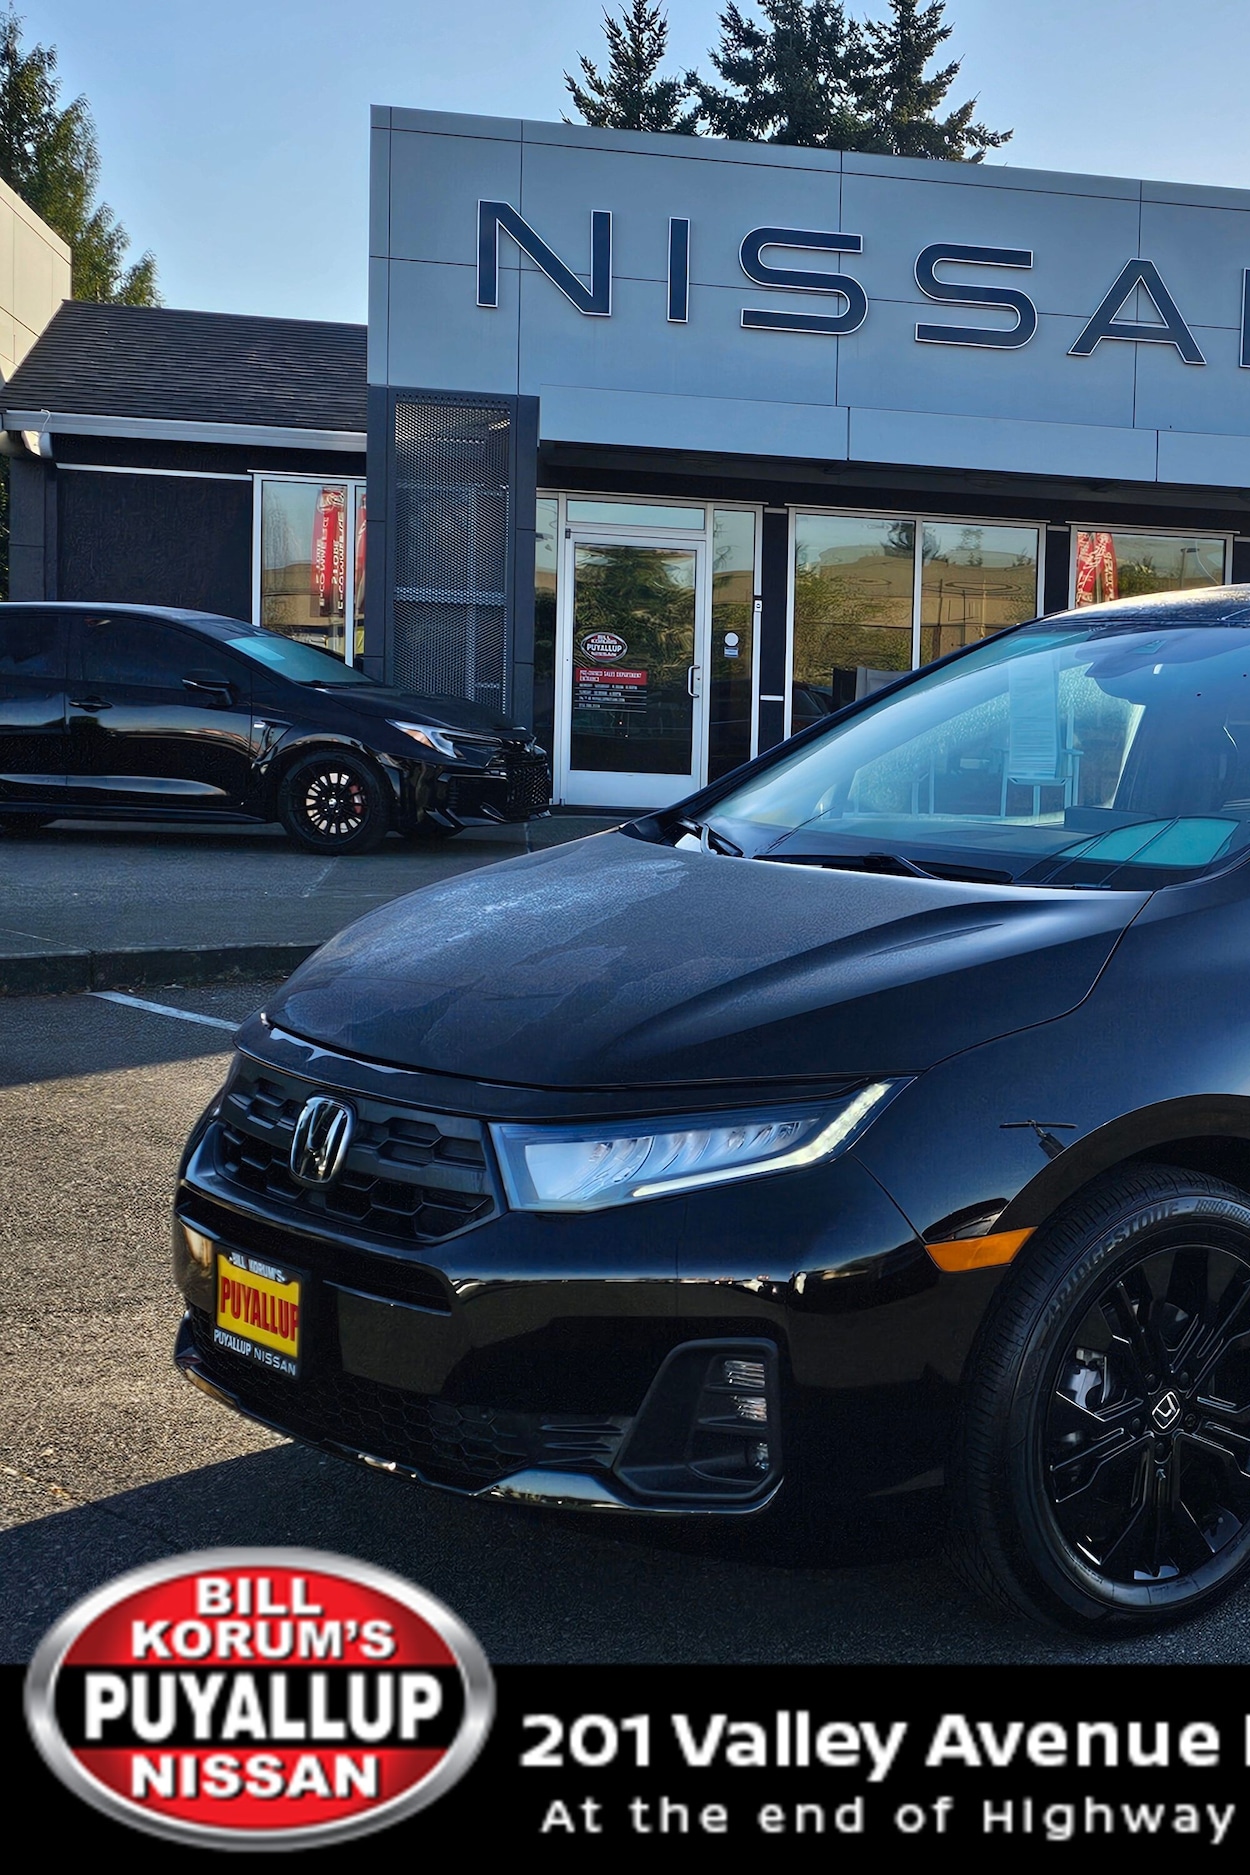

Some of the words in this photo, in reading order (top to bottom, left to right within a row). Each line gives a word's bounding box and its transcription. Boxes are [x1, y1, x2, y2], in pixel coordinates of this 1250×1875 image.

[587, 644, 622, 652] PUYALLUP
[220, 1276, 299, 1341] PUYALLUP
[213, 1329, 252, 1356] PUYALLUP
[254, 1347, 297, 1376] NISSAN
